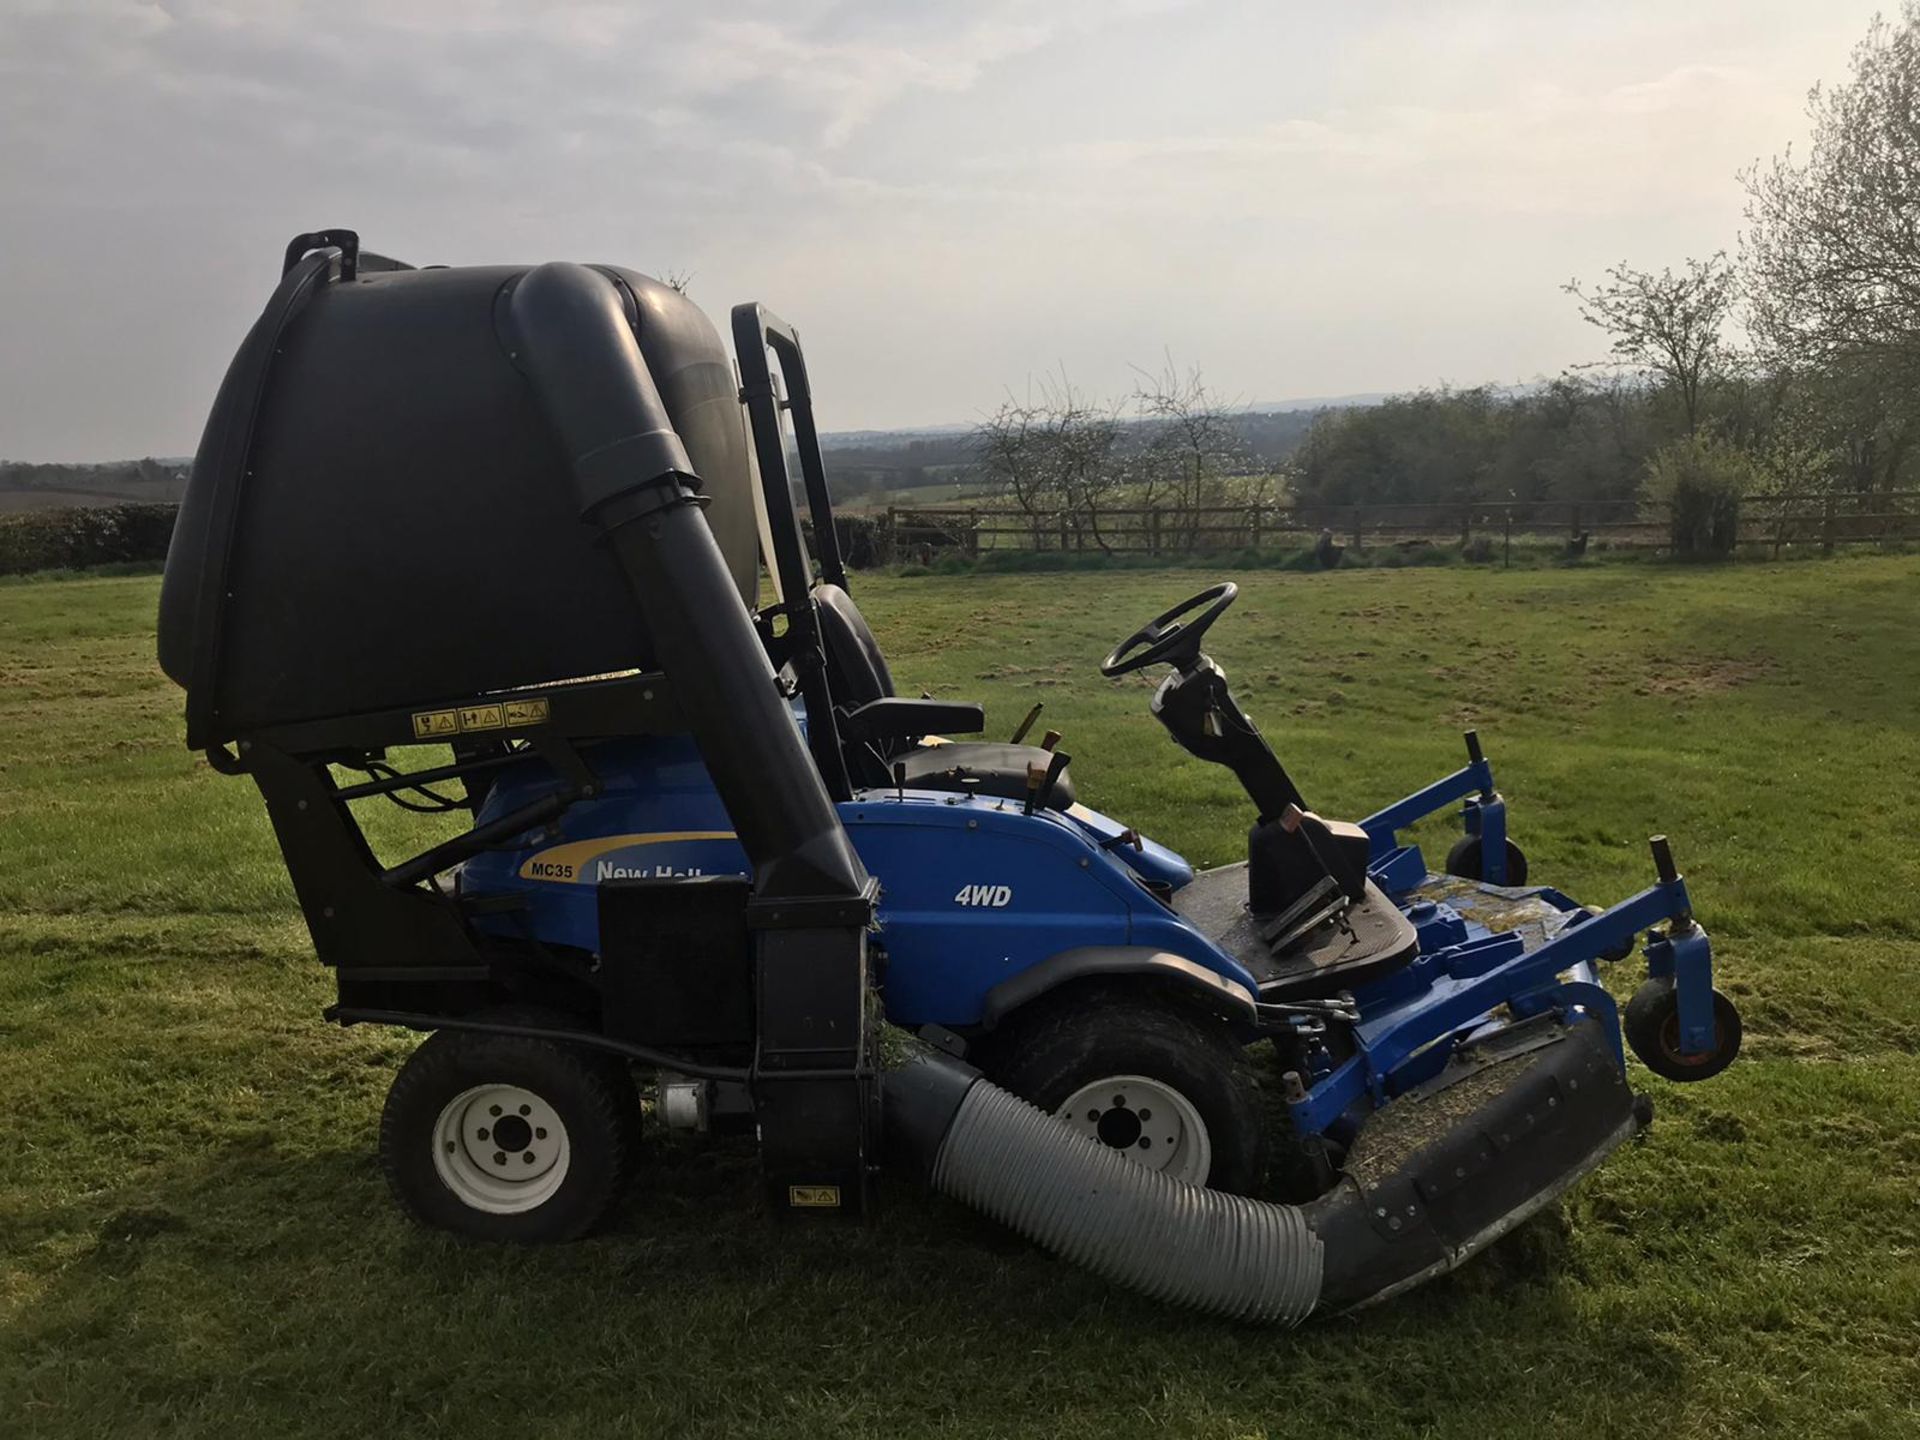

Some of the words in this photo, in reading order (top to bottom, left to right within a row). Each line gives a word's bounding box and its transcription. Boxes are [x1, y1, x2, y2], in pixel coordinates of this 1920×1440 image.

[531, 862, 573, 878] MC35
[597, 860, 648, 881] New
[954, 884, 1012, 907] 4WD
